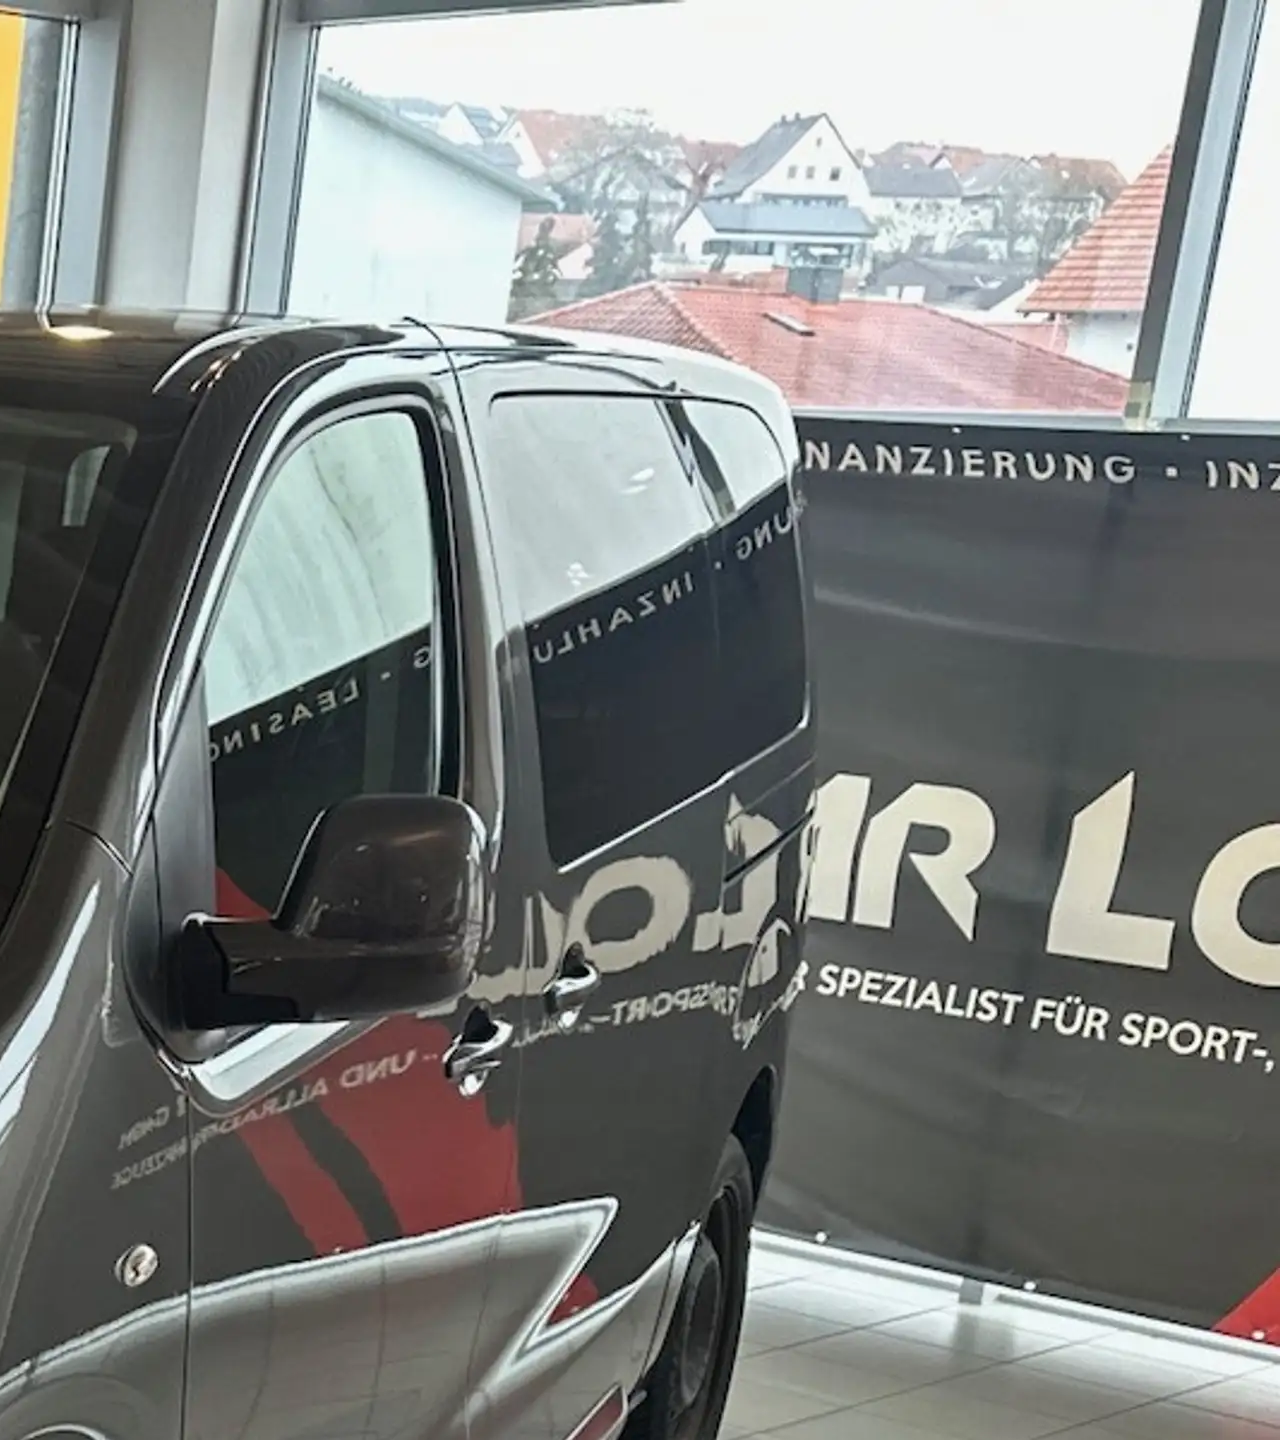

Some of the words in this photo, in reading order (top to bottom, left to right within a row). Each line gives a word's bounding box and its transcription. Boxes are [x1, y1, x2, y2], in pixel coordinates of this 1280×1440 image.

[804, 439, 1137, 484] NANZIERUNG
[816, 962, 1024, 1028] SPEZIALIST
[1030, 995, 1110, 1042] FÜR
[1118, 1011, 1276, 1073] SPORT-,
